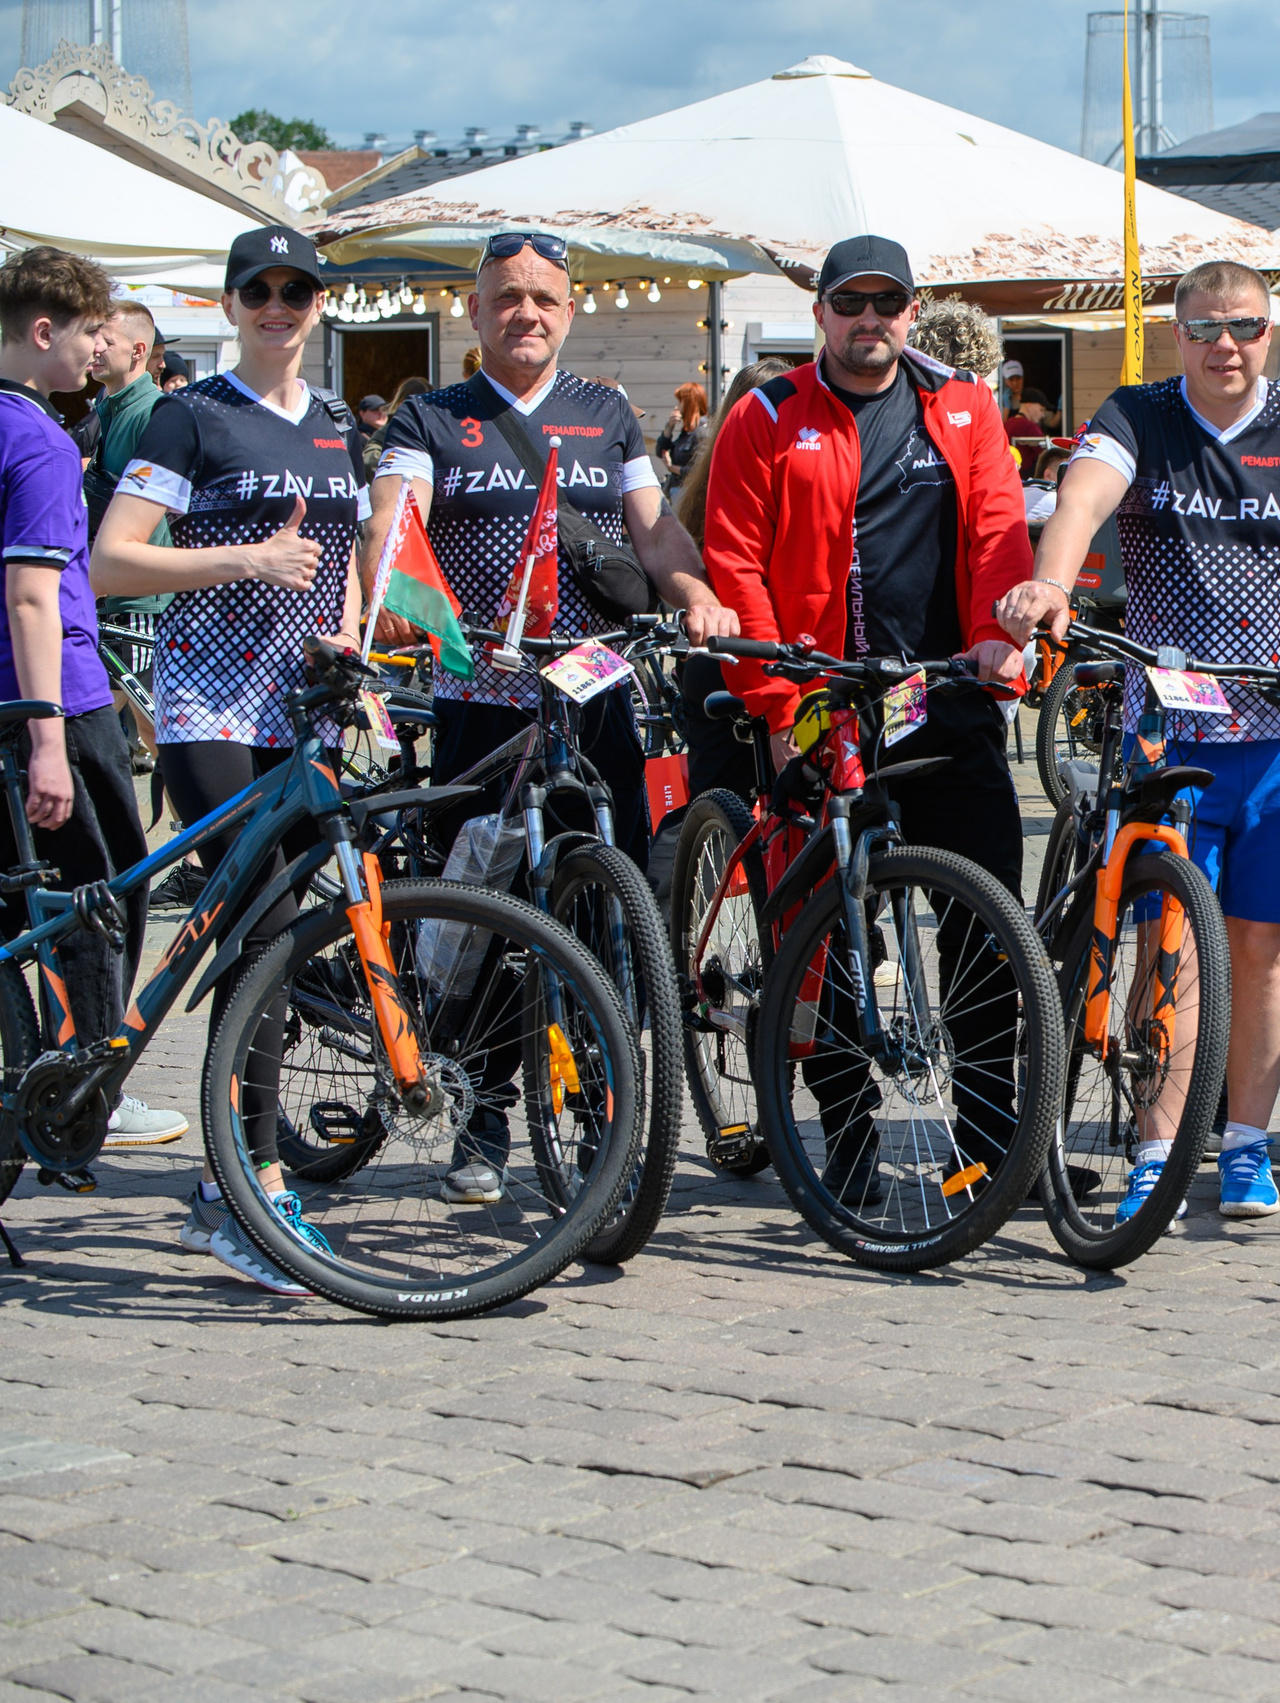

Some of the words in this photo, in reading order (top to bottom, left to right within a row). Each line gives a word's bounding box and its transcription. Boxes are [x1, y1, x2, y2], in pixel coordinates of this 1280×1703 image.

[460, 417, 484, 448] 3
[542, 424, 604, 438] РЕМАВТОДОР
[571, 678, 596, 695] 11863
[663, 784, 673, 807] LIFE
[397, 1288, 469, 1303] KENDA
